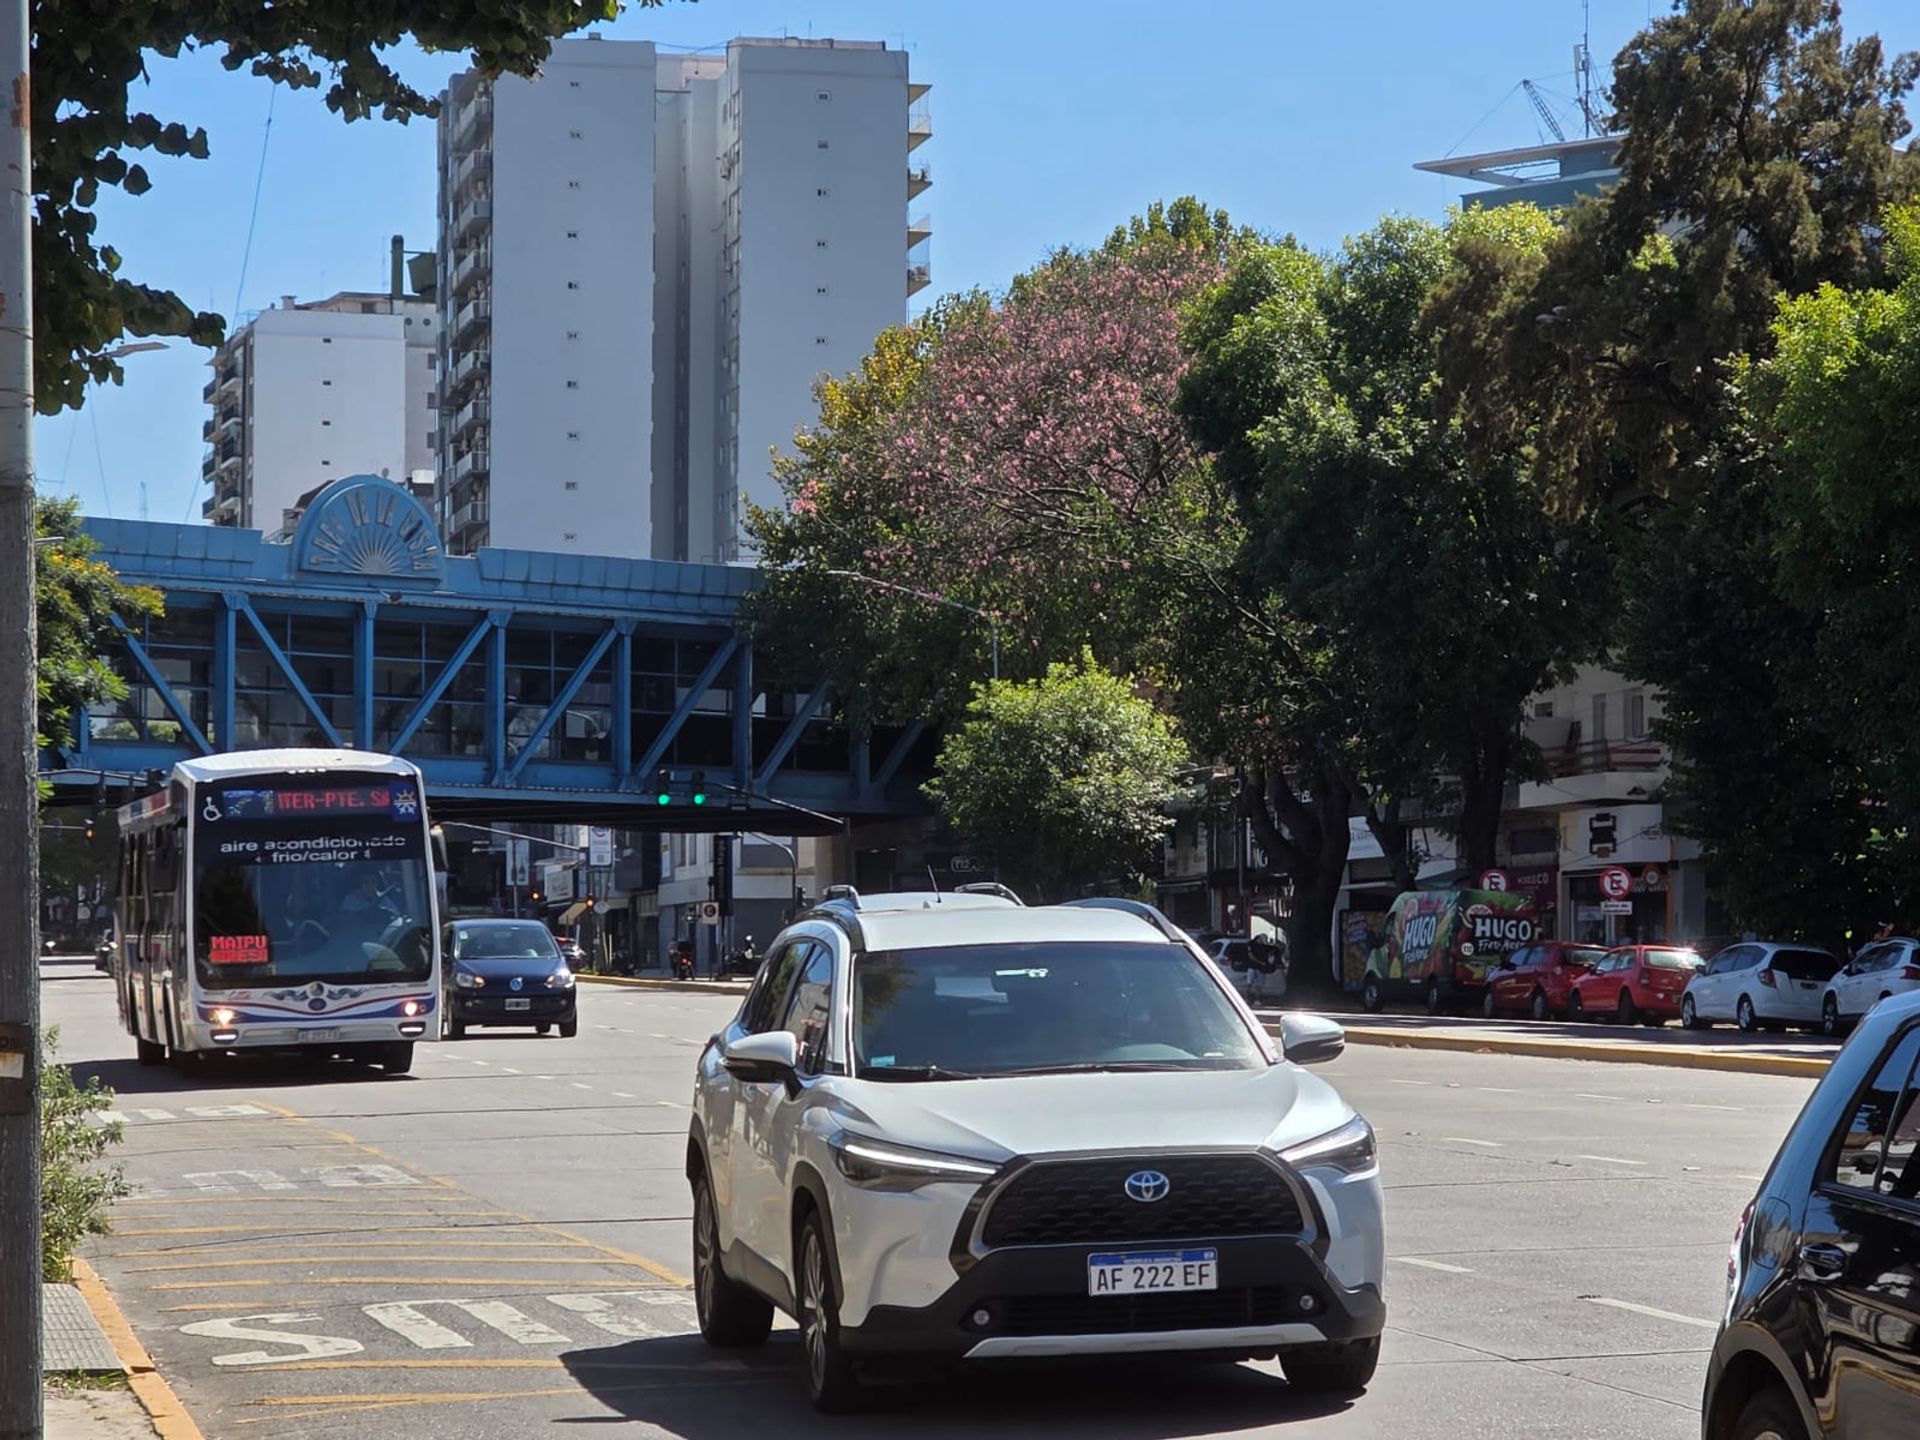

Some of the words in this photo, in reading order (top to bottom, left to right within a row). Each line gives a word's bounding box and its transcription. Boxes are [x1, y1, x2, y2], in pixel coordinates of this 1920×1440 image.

[220, 839, 258, 852] aire
[271, 849, 358, 863] frio/calor
[1402, 915, 1437, 953] HUGO
[1475, 917, 1532, 940] HUGO
[210, 935, 267, 950] MAIPU
[1097, 1267, 1123, 1291] AF
[1133, 1265, 1174, 1288] 222
[1183, 1263, 1210, 1286] EF
